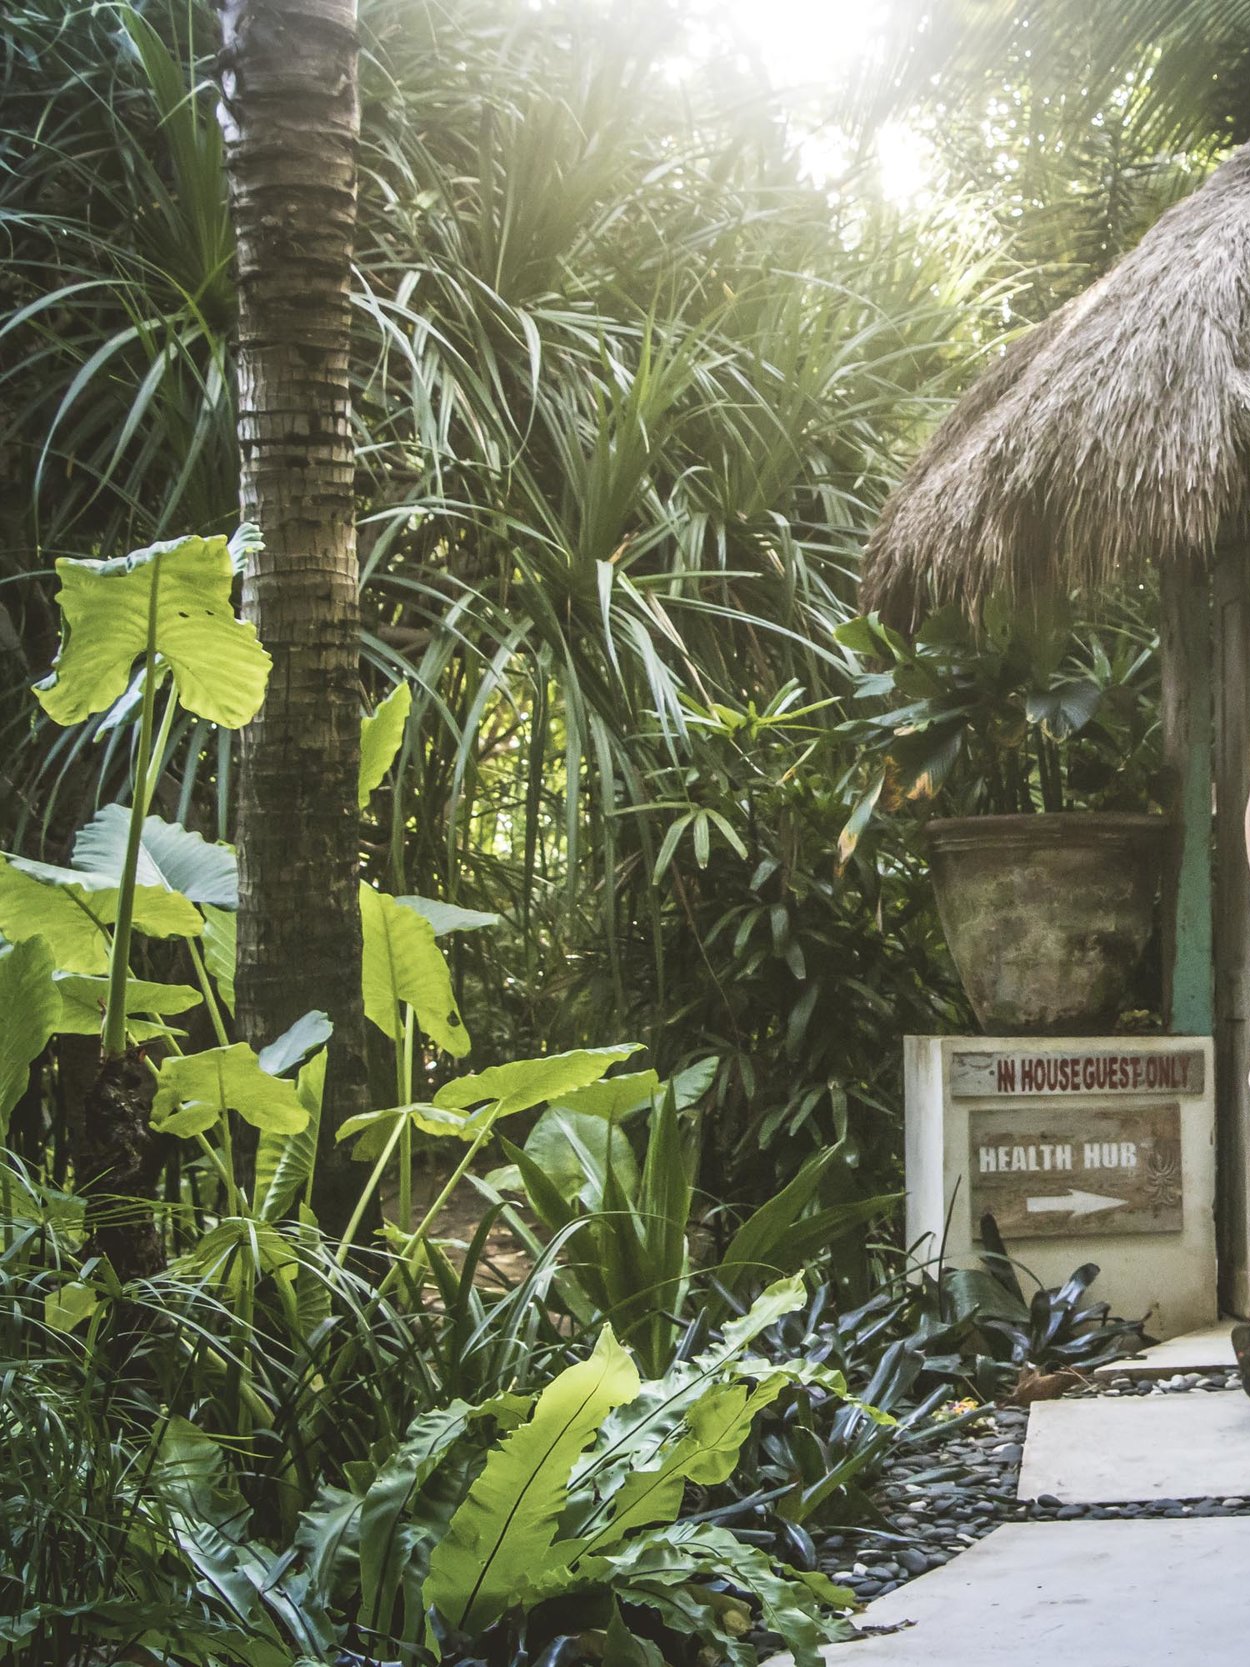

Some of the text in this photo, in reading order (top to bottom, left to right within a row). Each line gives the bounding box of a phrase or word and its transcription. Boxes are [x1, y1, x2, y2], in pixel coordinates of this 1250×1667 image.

[997, 1055, 1191, 1093] IN HOUSE GUEST ONLY
[979, 1142, 1137, 1173] HEALTH HUB
